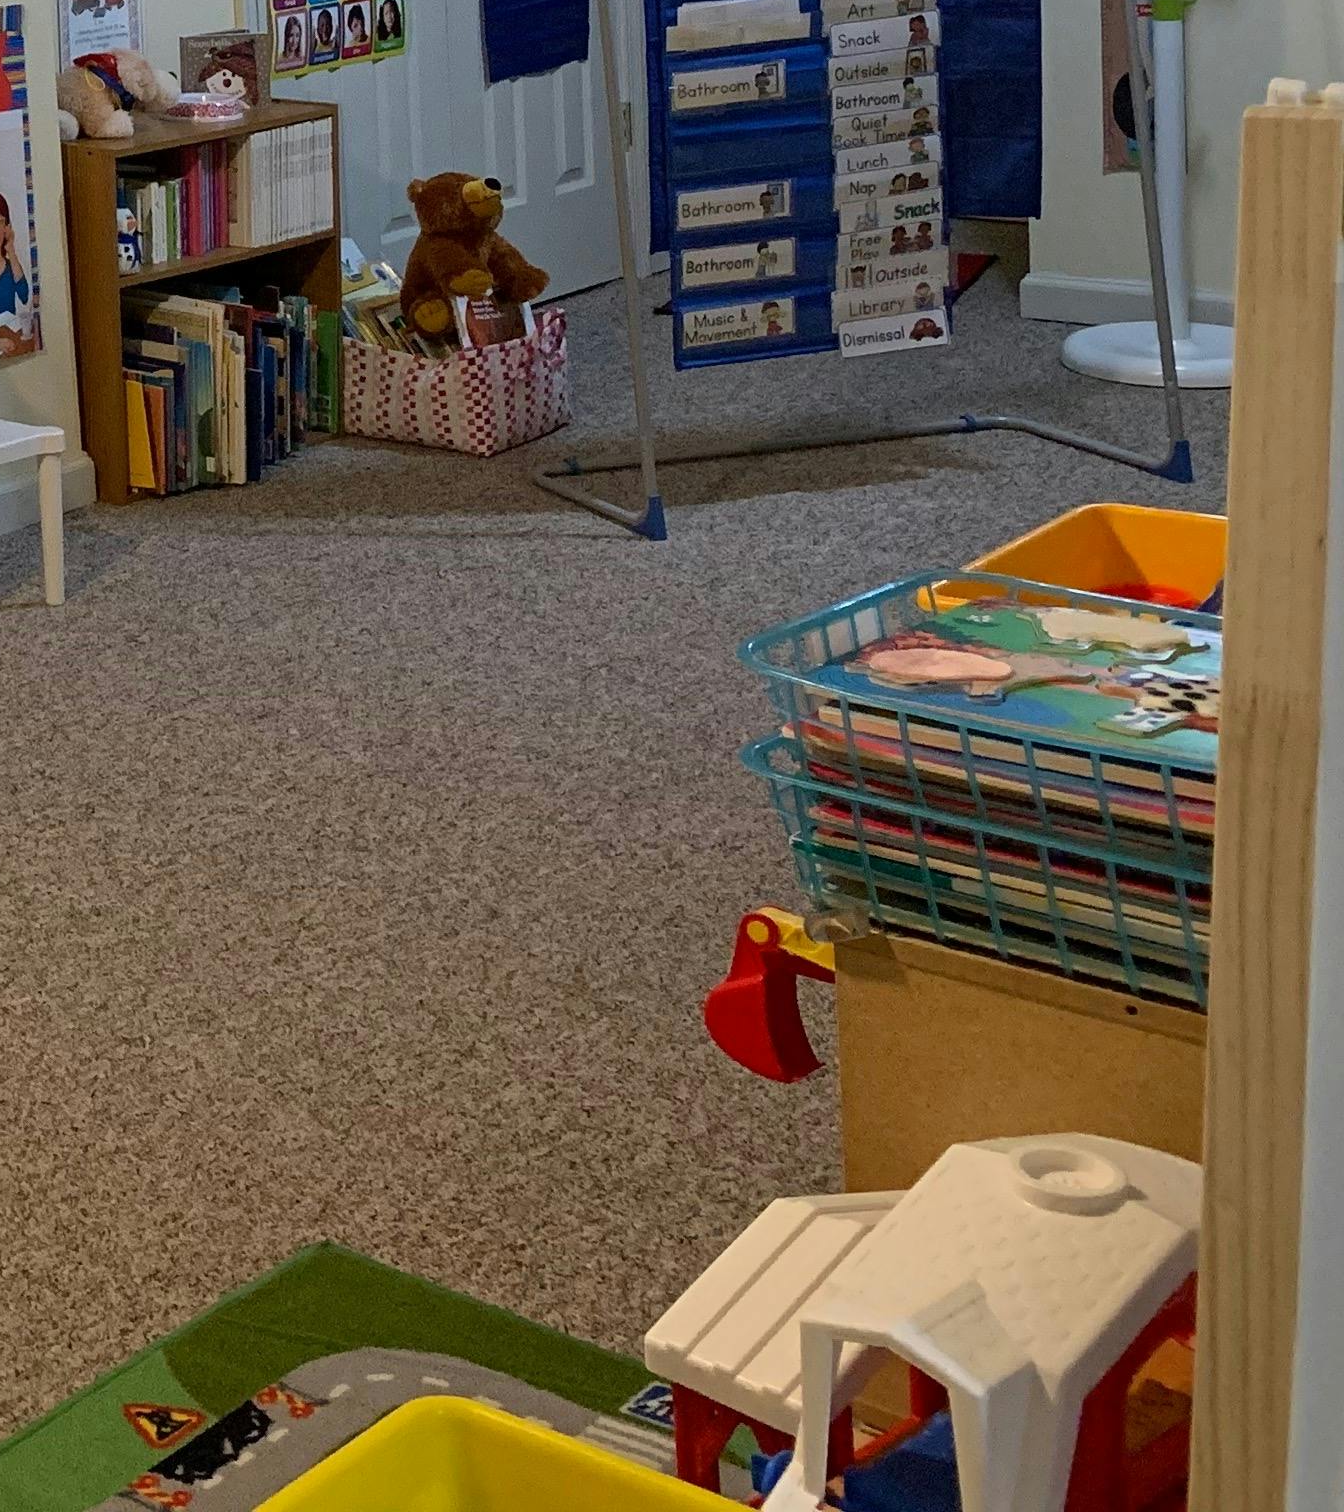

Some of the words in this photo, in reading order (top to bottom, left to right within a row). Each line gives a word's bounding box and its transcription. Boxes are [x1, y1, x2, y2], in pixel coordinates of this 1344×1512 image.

[838, 34, 880, 48] Snack
[835, 64, 888, 81] Outside
[678, 80, 750, 98] Bathroom
[848, 153, 888, 171] Lunch
[849, 298, 904, 317] Library
[694, 311, 735, 328] Music
[843, 327, 904, 348] Dismissal
